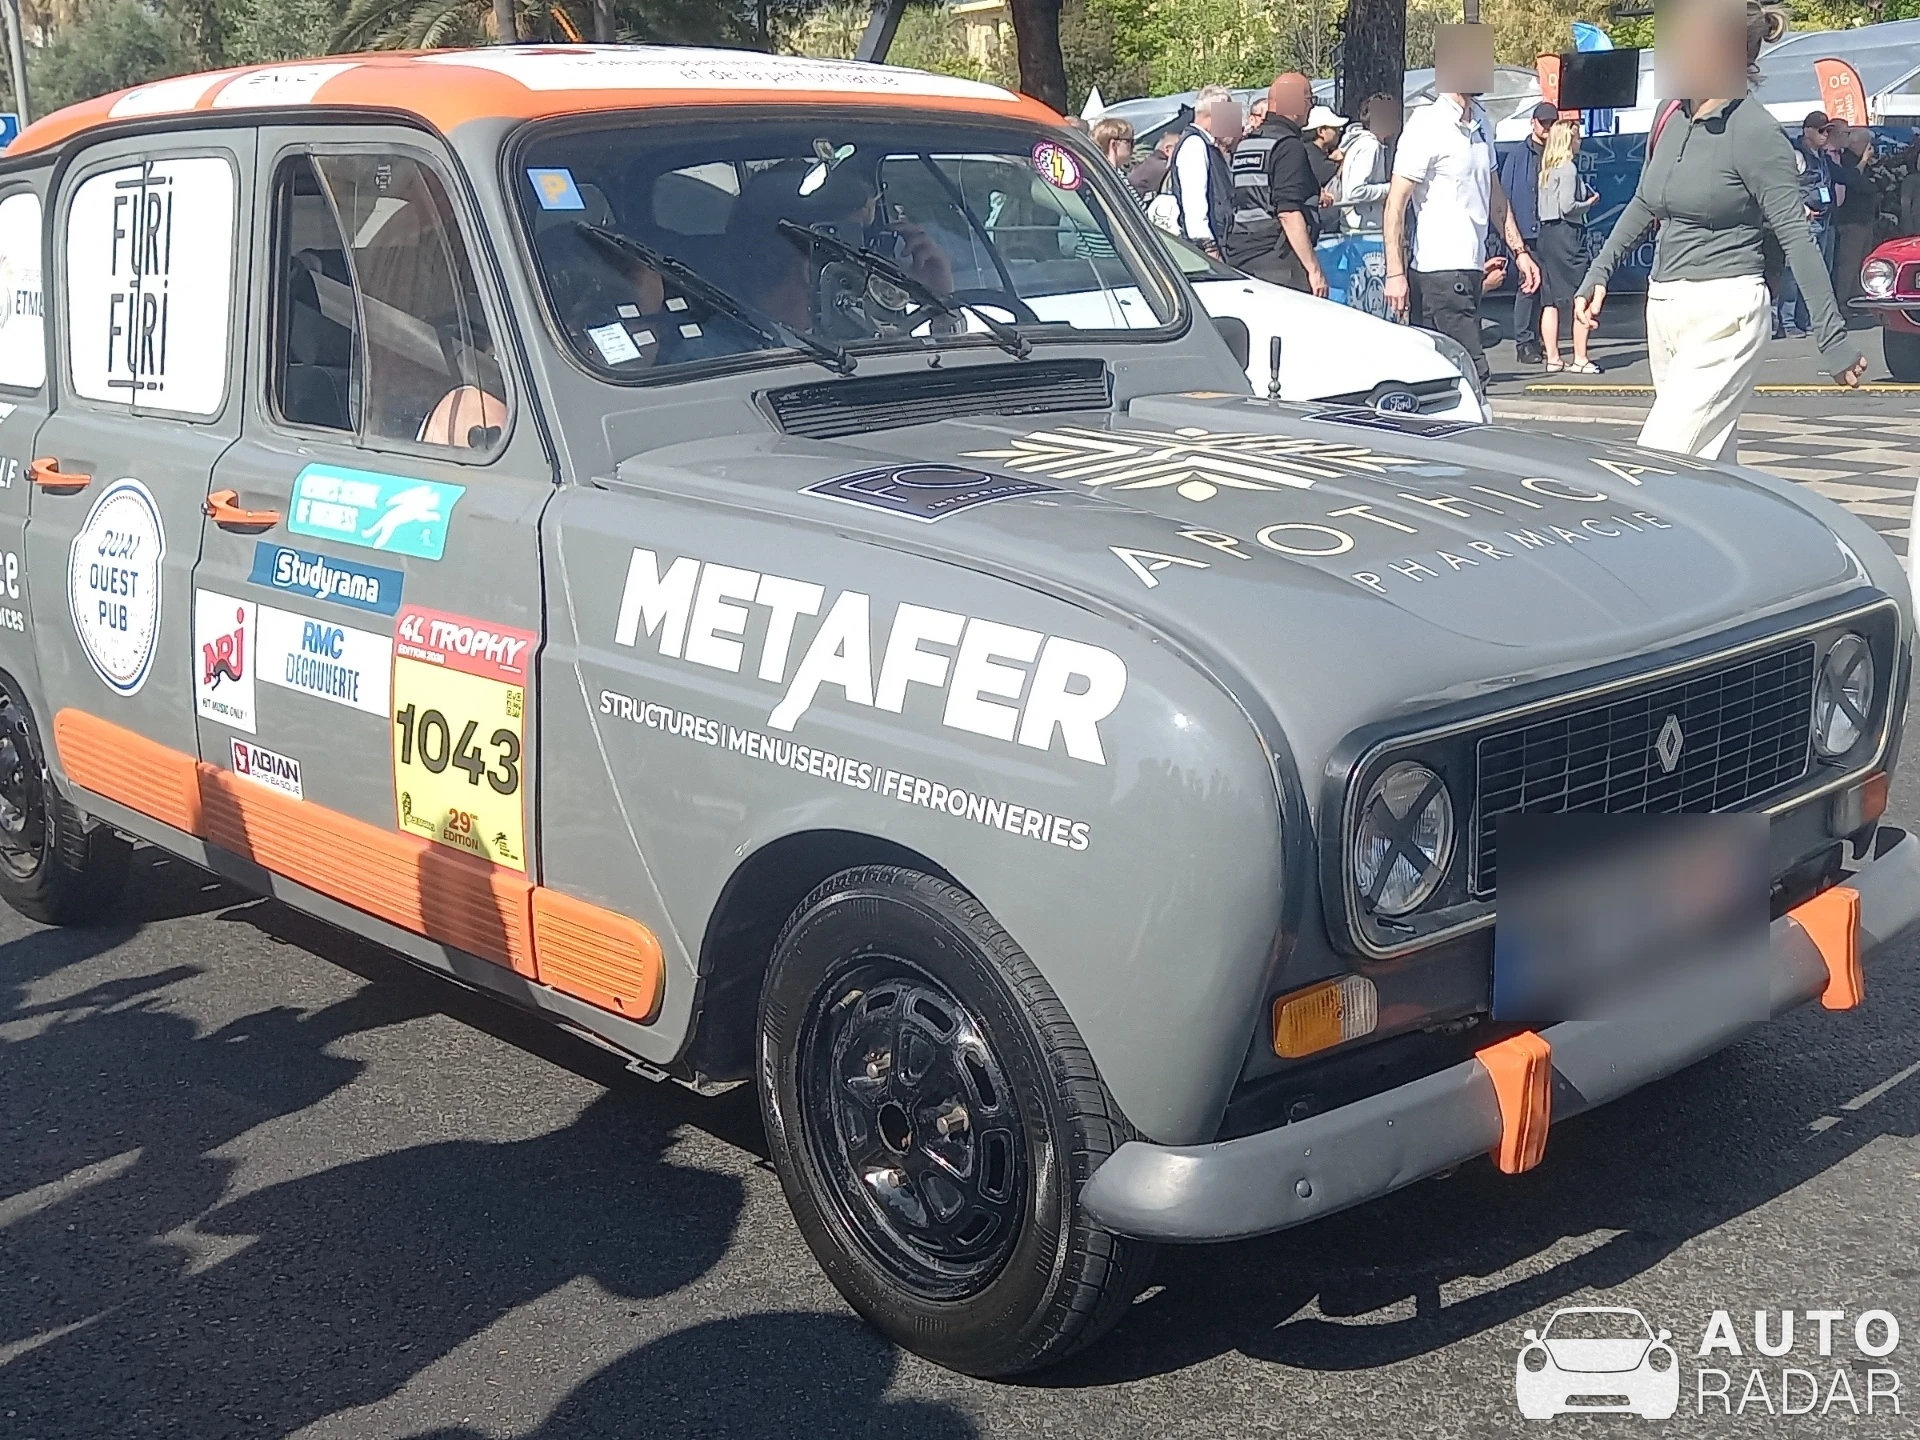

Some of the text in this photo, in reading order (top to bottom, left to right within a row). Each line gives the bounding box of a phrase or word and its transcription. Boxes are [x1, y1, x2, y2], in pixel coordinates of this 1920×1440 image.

[1548, 72, 1559, 87] 0
[1828, 71, 1850, 89] 06
[1389, 396, 1414, 412] Ford
[0, 456, 19, 489] LF
[1109, 455, 1678, 589] APOTHICA
[98, 530, 141, 561] QUAI
[1351, 509, 1674, 594] PHARMACIE
[90, 563, 139, 598] OUEST
[274, 549, 380, 604] Studyrama
[99, 599, 127, 632] PUB
[301, 620, 345, 660] RMC
[398, 614, 528, 666] 4L TROPHY
[613, 546, 1129, 766] METAFER
[212, 700, 229, 716] MUSIC
[230, 706, 244, 720] ONLY
[252, 749, 299, 783] ABIAN
[397, 702, 521, 796] 1043
[600, 688, 1091, 852] STRUCTURES MENUISERIES FERRONNERIES
